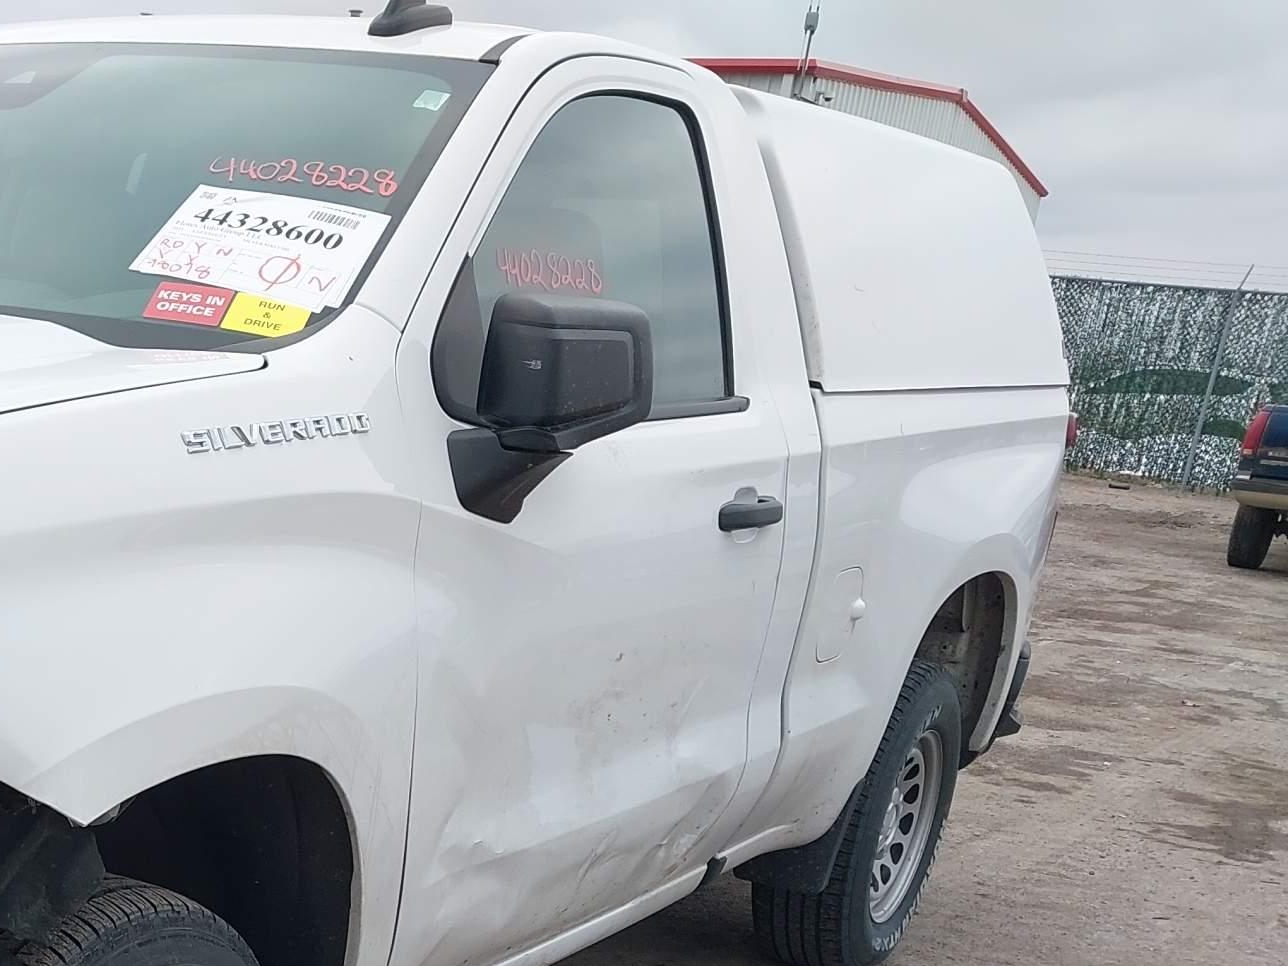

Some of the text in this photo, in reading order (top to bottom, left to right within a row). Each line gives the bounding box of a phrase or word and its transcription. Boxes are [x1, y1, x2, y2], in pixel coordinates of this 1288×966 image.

[210, 156, 397, 196] 44028228
[194, 208, 343, 249] 44328600
[496, 248, 602, 294] 44028228
[158, 289, 225, 306] KEYS IN
[258, 300, 286, 312] RUN
[156, 301, 216, 317] OFFICE
[263, 311, 271, 319] &
[243, 317, 283, 331] DRIVE
[181, 412, 371, 454] SILVERADO
